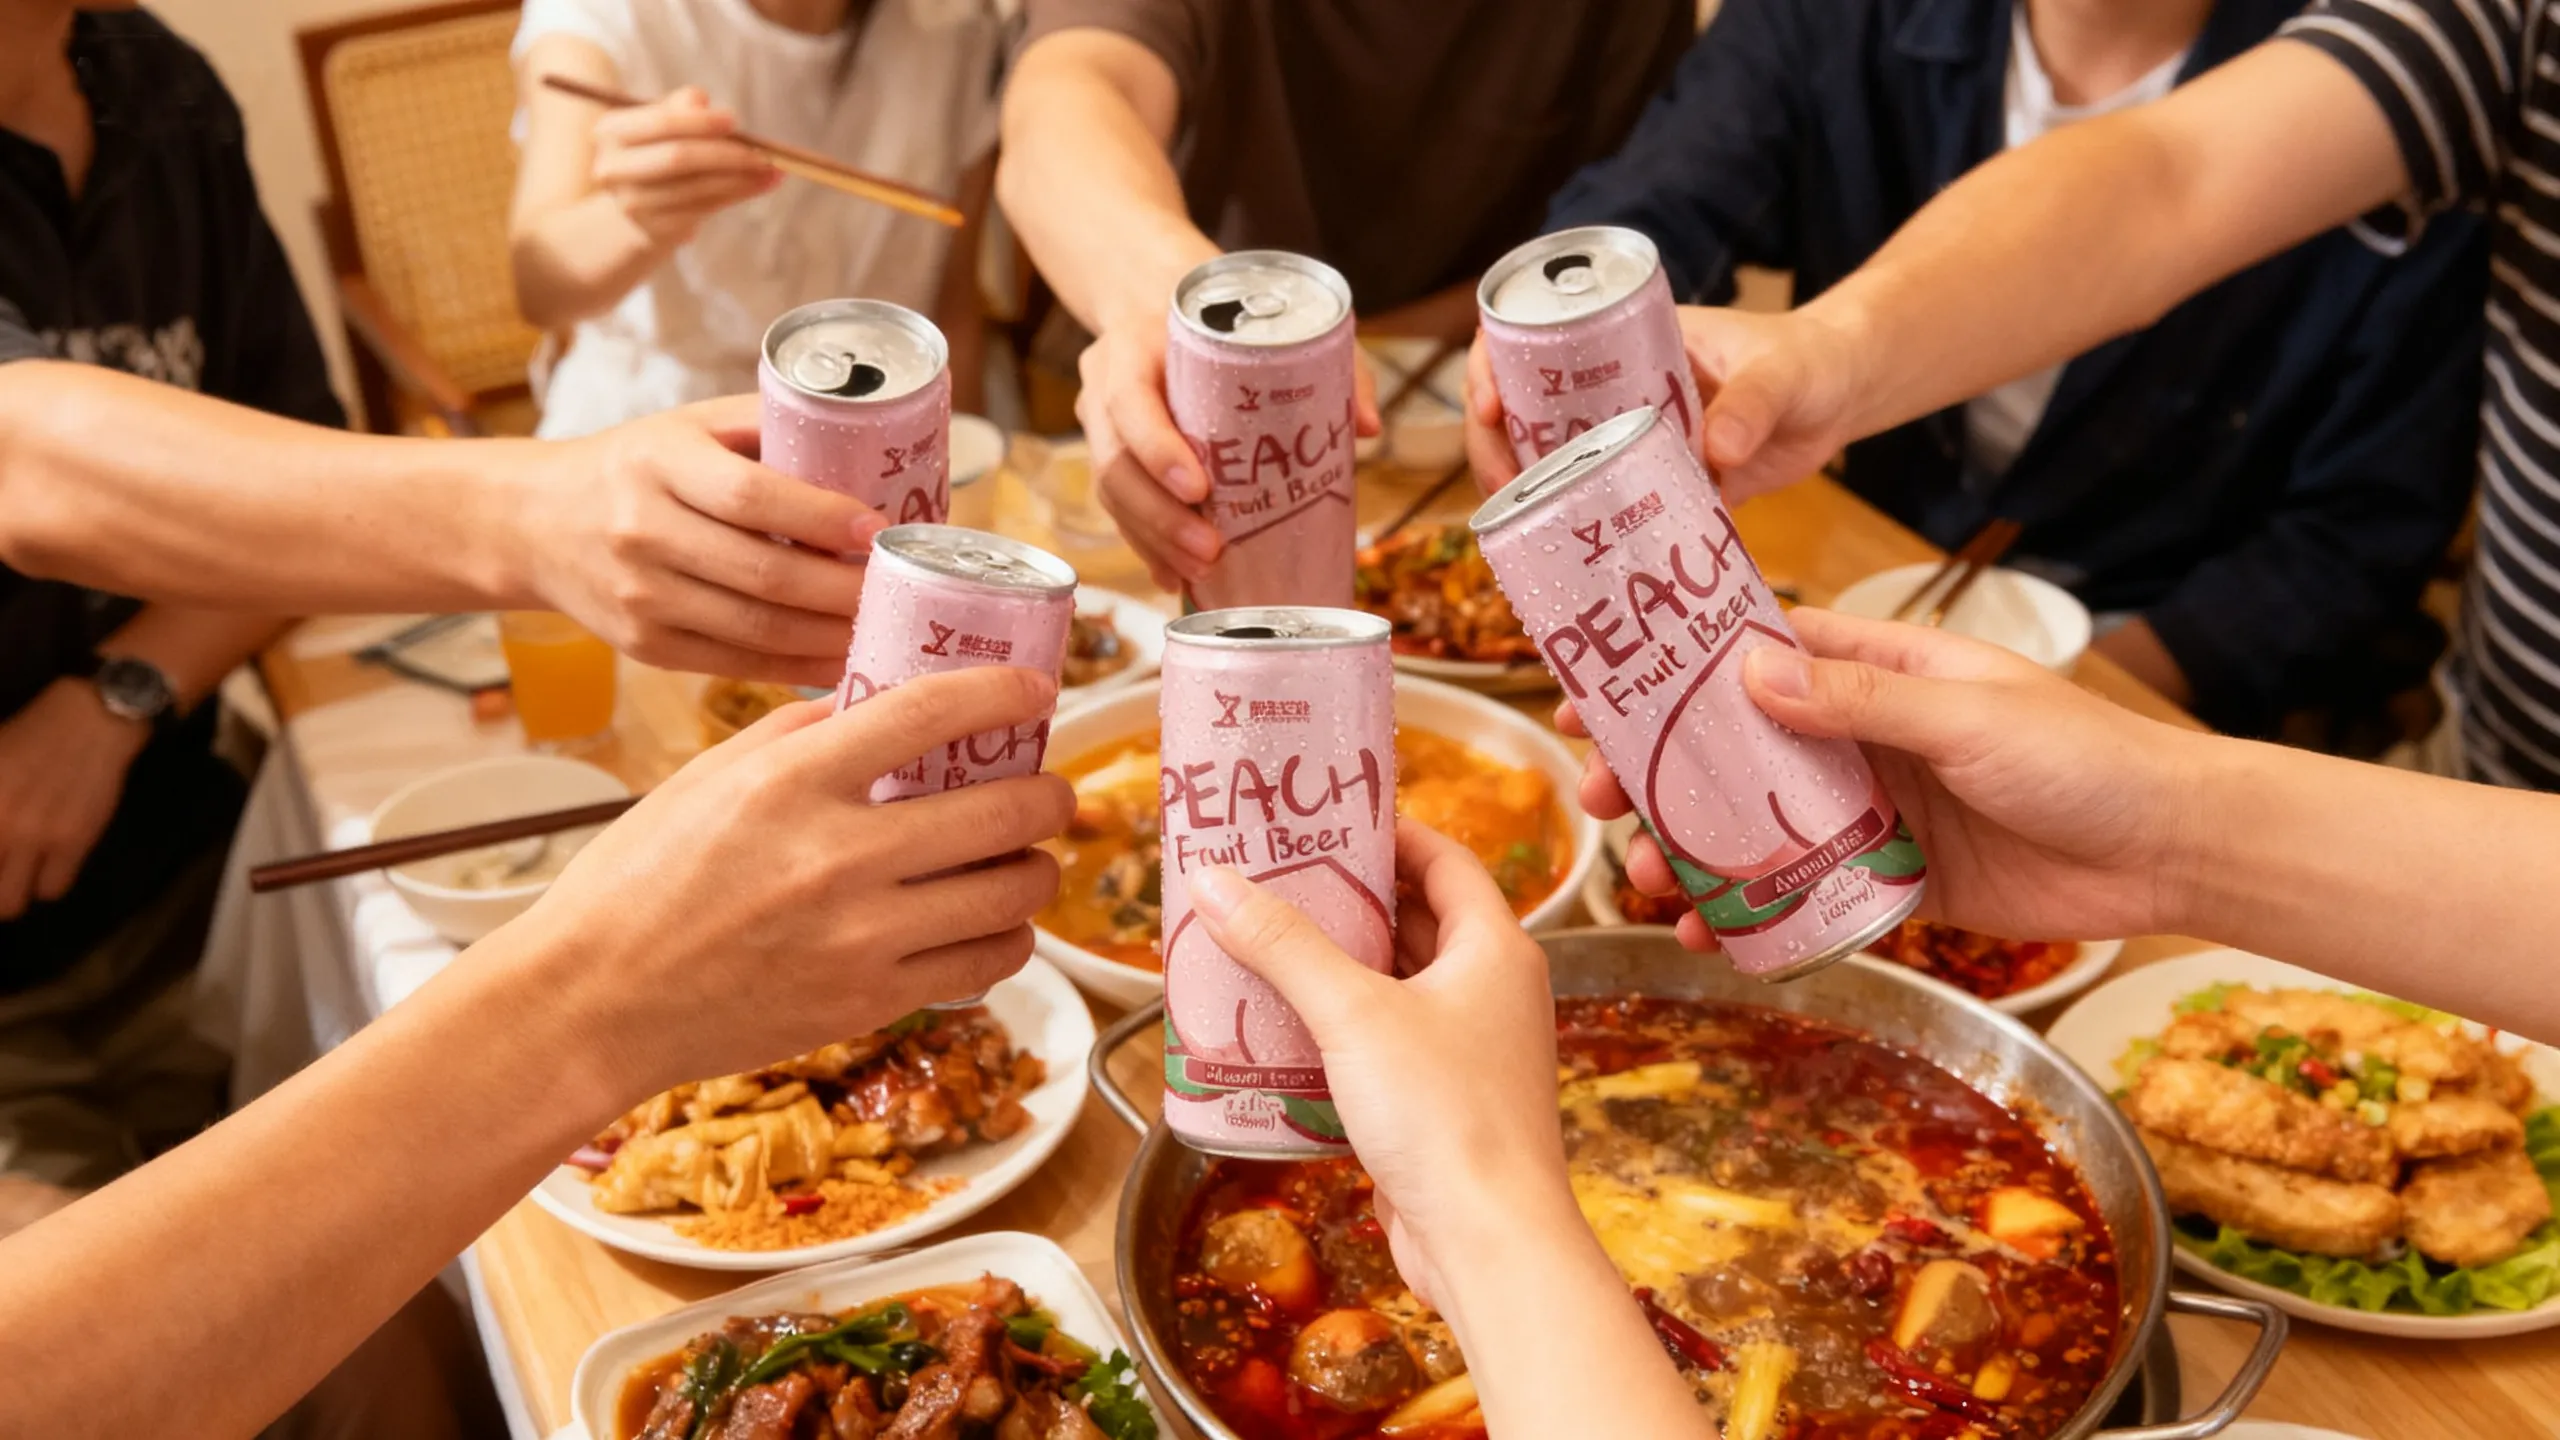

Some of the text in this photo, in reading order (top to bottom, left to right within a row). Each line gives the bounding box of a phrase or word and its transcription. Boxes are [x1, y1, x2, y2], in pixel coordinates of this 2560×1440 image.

[1543, 506, 1765, 699] PEACH
[1598, 583, 1758, 717] Fruit Beer
[1160, 747, 1382, 836] PEACH
[1175, 826, 1353, 874] Fruit Beer
